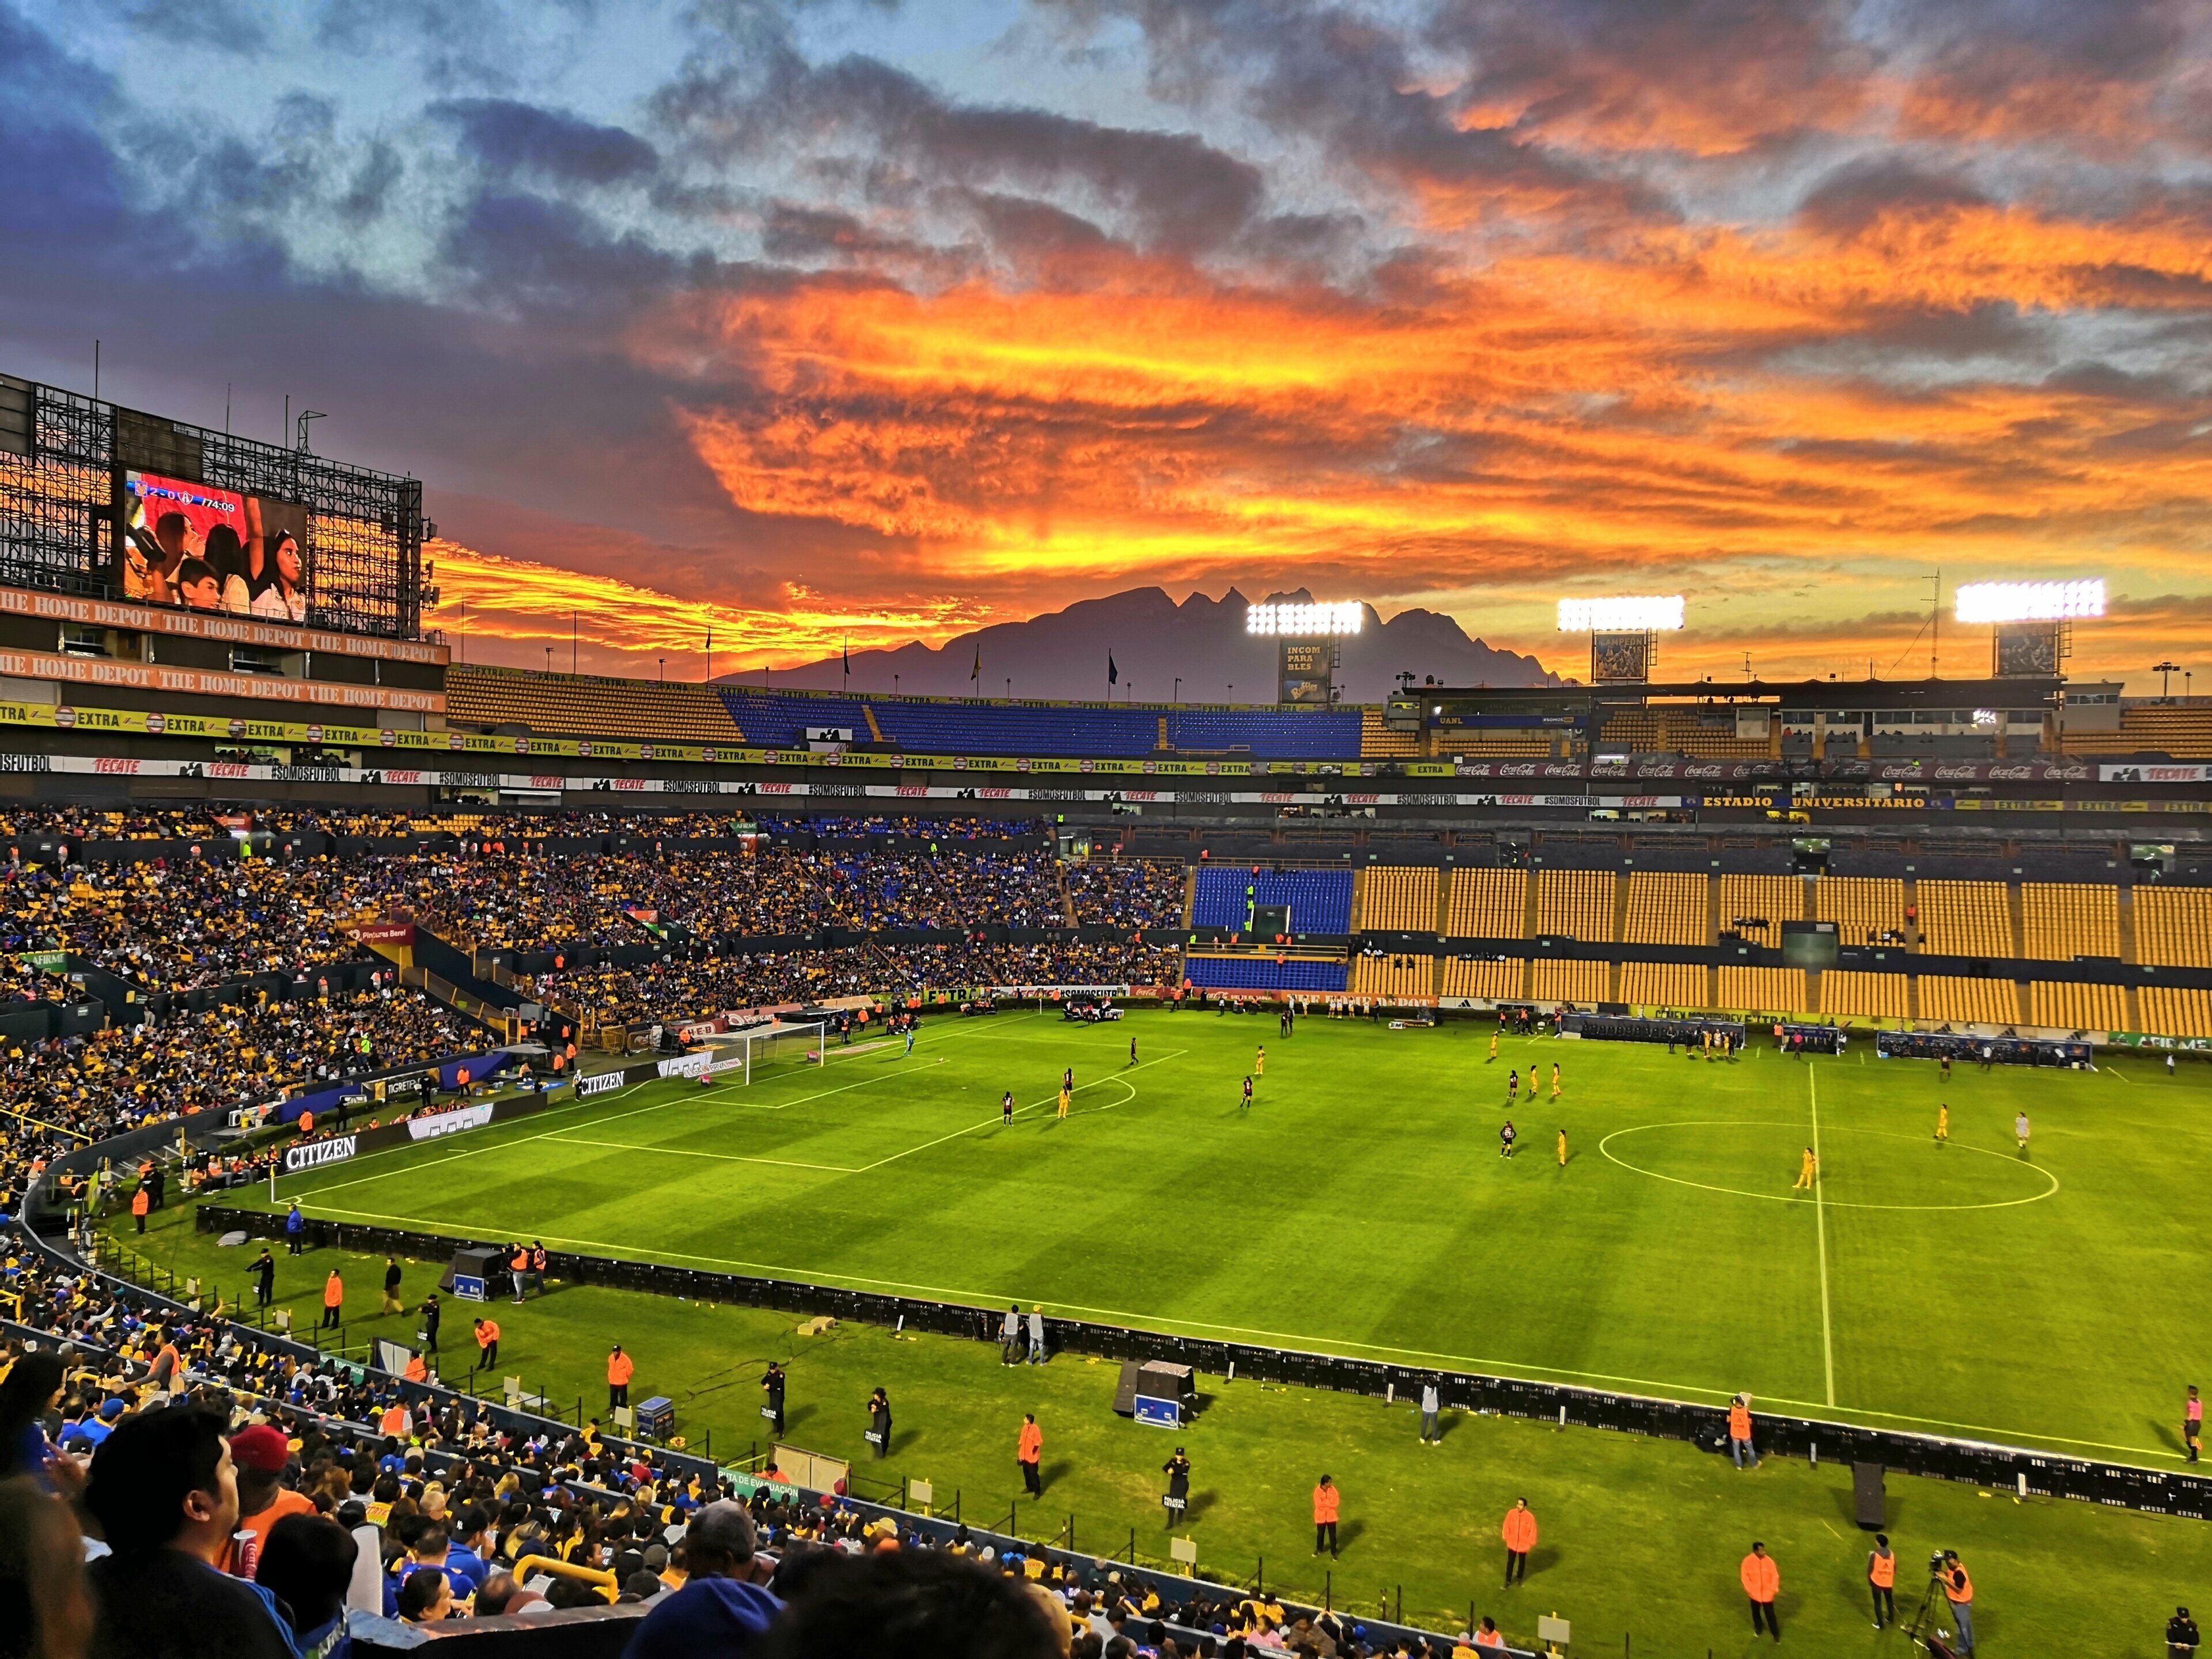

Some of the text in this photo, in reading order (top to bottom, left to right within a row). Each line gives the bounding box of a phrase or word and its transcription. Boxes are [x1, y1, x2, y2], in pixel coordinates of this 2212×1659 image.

[150, 488, 158, 497] 2
[168, 491, 175, 500] 0
[207, 499, 234, 512] 74:09
[34, 596, 89, 620] HOME
[94, 605, 153, 627] DEPOT
[163, 615, 198, 632] THE
[203, 619, 249, 640] HOME
[254, 627, 304, 646] DEPOT
[309, 634, 341, 650] THE
[346, 638, 387, 656] HOME
[391, 643, 437, 661] DEPOT
[475, 666, 504, 677] EXTRA
[537, 672, 566, 682] EXTRA
[32, 657, 86, 679] HOME
[92, 664, 150, 684] DEPOT
[160, 672, 195, 689] THE
[200, 675, 247, 694] HOME
[251, 681, 302, 698] DEPOT
[308, 685, 339, 702] THE
[344, 690, 385, 706] HOME
[389, 695, 435, 710] DEPOT
[599, 678, 627, 687] EXTRA
[782, 691, 809, 699] EXTRA
[1290, 681, 1318, 700] Ruffles
[903, 696, 931, 704] EXTRA
[1024, 700, 1050, 709] EXTRA
[78, 713, 120, 726] EXTRA
[168, 718, 205, 732] EXTRA
[248, 724, 283, 737] EXTRA
[325, 729, 358, 741] EXTRA
[397, 734, 429, 745] EXTRA
[465, 738, 495, 749] EXTRA
[531, 742, 559, 752] EXTRA
[593, 745, 622, 756] EXTRA
[655, 748, 684, 758] EXTRA
[718, 751, 745, 761] EXTRA
[779, 753, 808, 762] EXTRA
[94, 758, 141, 773] TECATE
[842, 756, 871, 764] EXTRA
[906, 758, 934, 767] EXTRA
[969, 760, 998, 768] EXTRA
[209, 763, 250, 777] TECATE
[1032, 762, 1060, 770] EXTRA
[1095, 762, 1124, 771] EXTRA
[1158, 763, 1187, 772] EXTRA
[1221, 764, 1250, 773] EXTRA
[1456, 764, 1491, 775] Coca-Cola
[1500, 764, 1536, 775] Coca-Cola
[1545, 764, 1582, 776] Coca-Cola
[1591, 764, 1628, 777] Coca-Cola
[1638, 765, 1675, 777] Coca-Cola
[1684, 765, 1722, 777] Coca-Cola
[272, 766, 340, 781] #SOMOSFUTBOL
[385, 770, 421, 783] TECATE
[1935, 766, 1977, 778] Coca-Cola
[1988, 766, 2032, 779] Coca-Cola
[2147, 768, 2200, 780] TECATE
[440, 771, 501, 787] #SOMOSFUTBOL
[530, 777, 564, 788] TECATE
[614, 779, 646, 790] TECATE
[663, 781, 720, 793] #SOMOSFUTBOL
[760, 783, 791, 793] TECATE
[808, 785, 866, 796] #SOMOSFUTBOL
[896, 787, 929, 797] TECATE
[979, 788, 1011, 798] TECATE
[1028, 789, 1086, 800] #SOMOSFUTBOL
[1125, 791, 1158, 801] TECATE
[1174, 792, 1233, 802] #SOMOSFUTBOL
[1260, 793, 1294, 802] TECATE
[1347, 794, 1380, 803] TECATE
[1397, 794, 1458, 805] #SOMOSFUTBOL
[1500, 796, 1535, 804] TECATE
[1544, 797, 1601, 805] #SOMOSFUTBOL
[1623, 797, 1659, 806] TECATE
[1703, 797, 1925, 808] ESTADIO UNIVERSITARIO
[581, 1071, 624, 1094] CITIZEN
[286, 1135, 357, 1169] CITIZEN
[739, 1476, 749, 1484] DE
